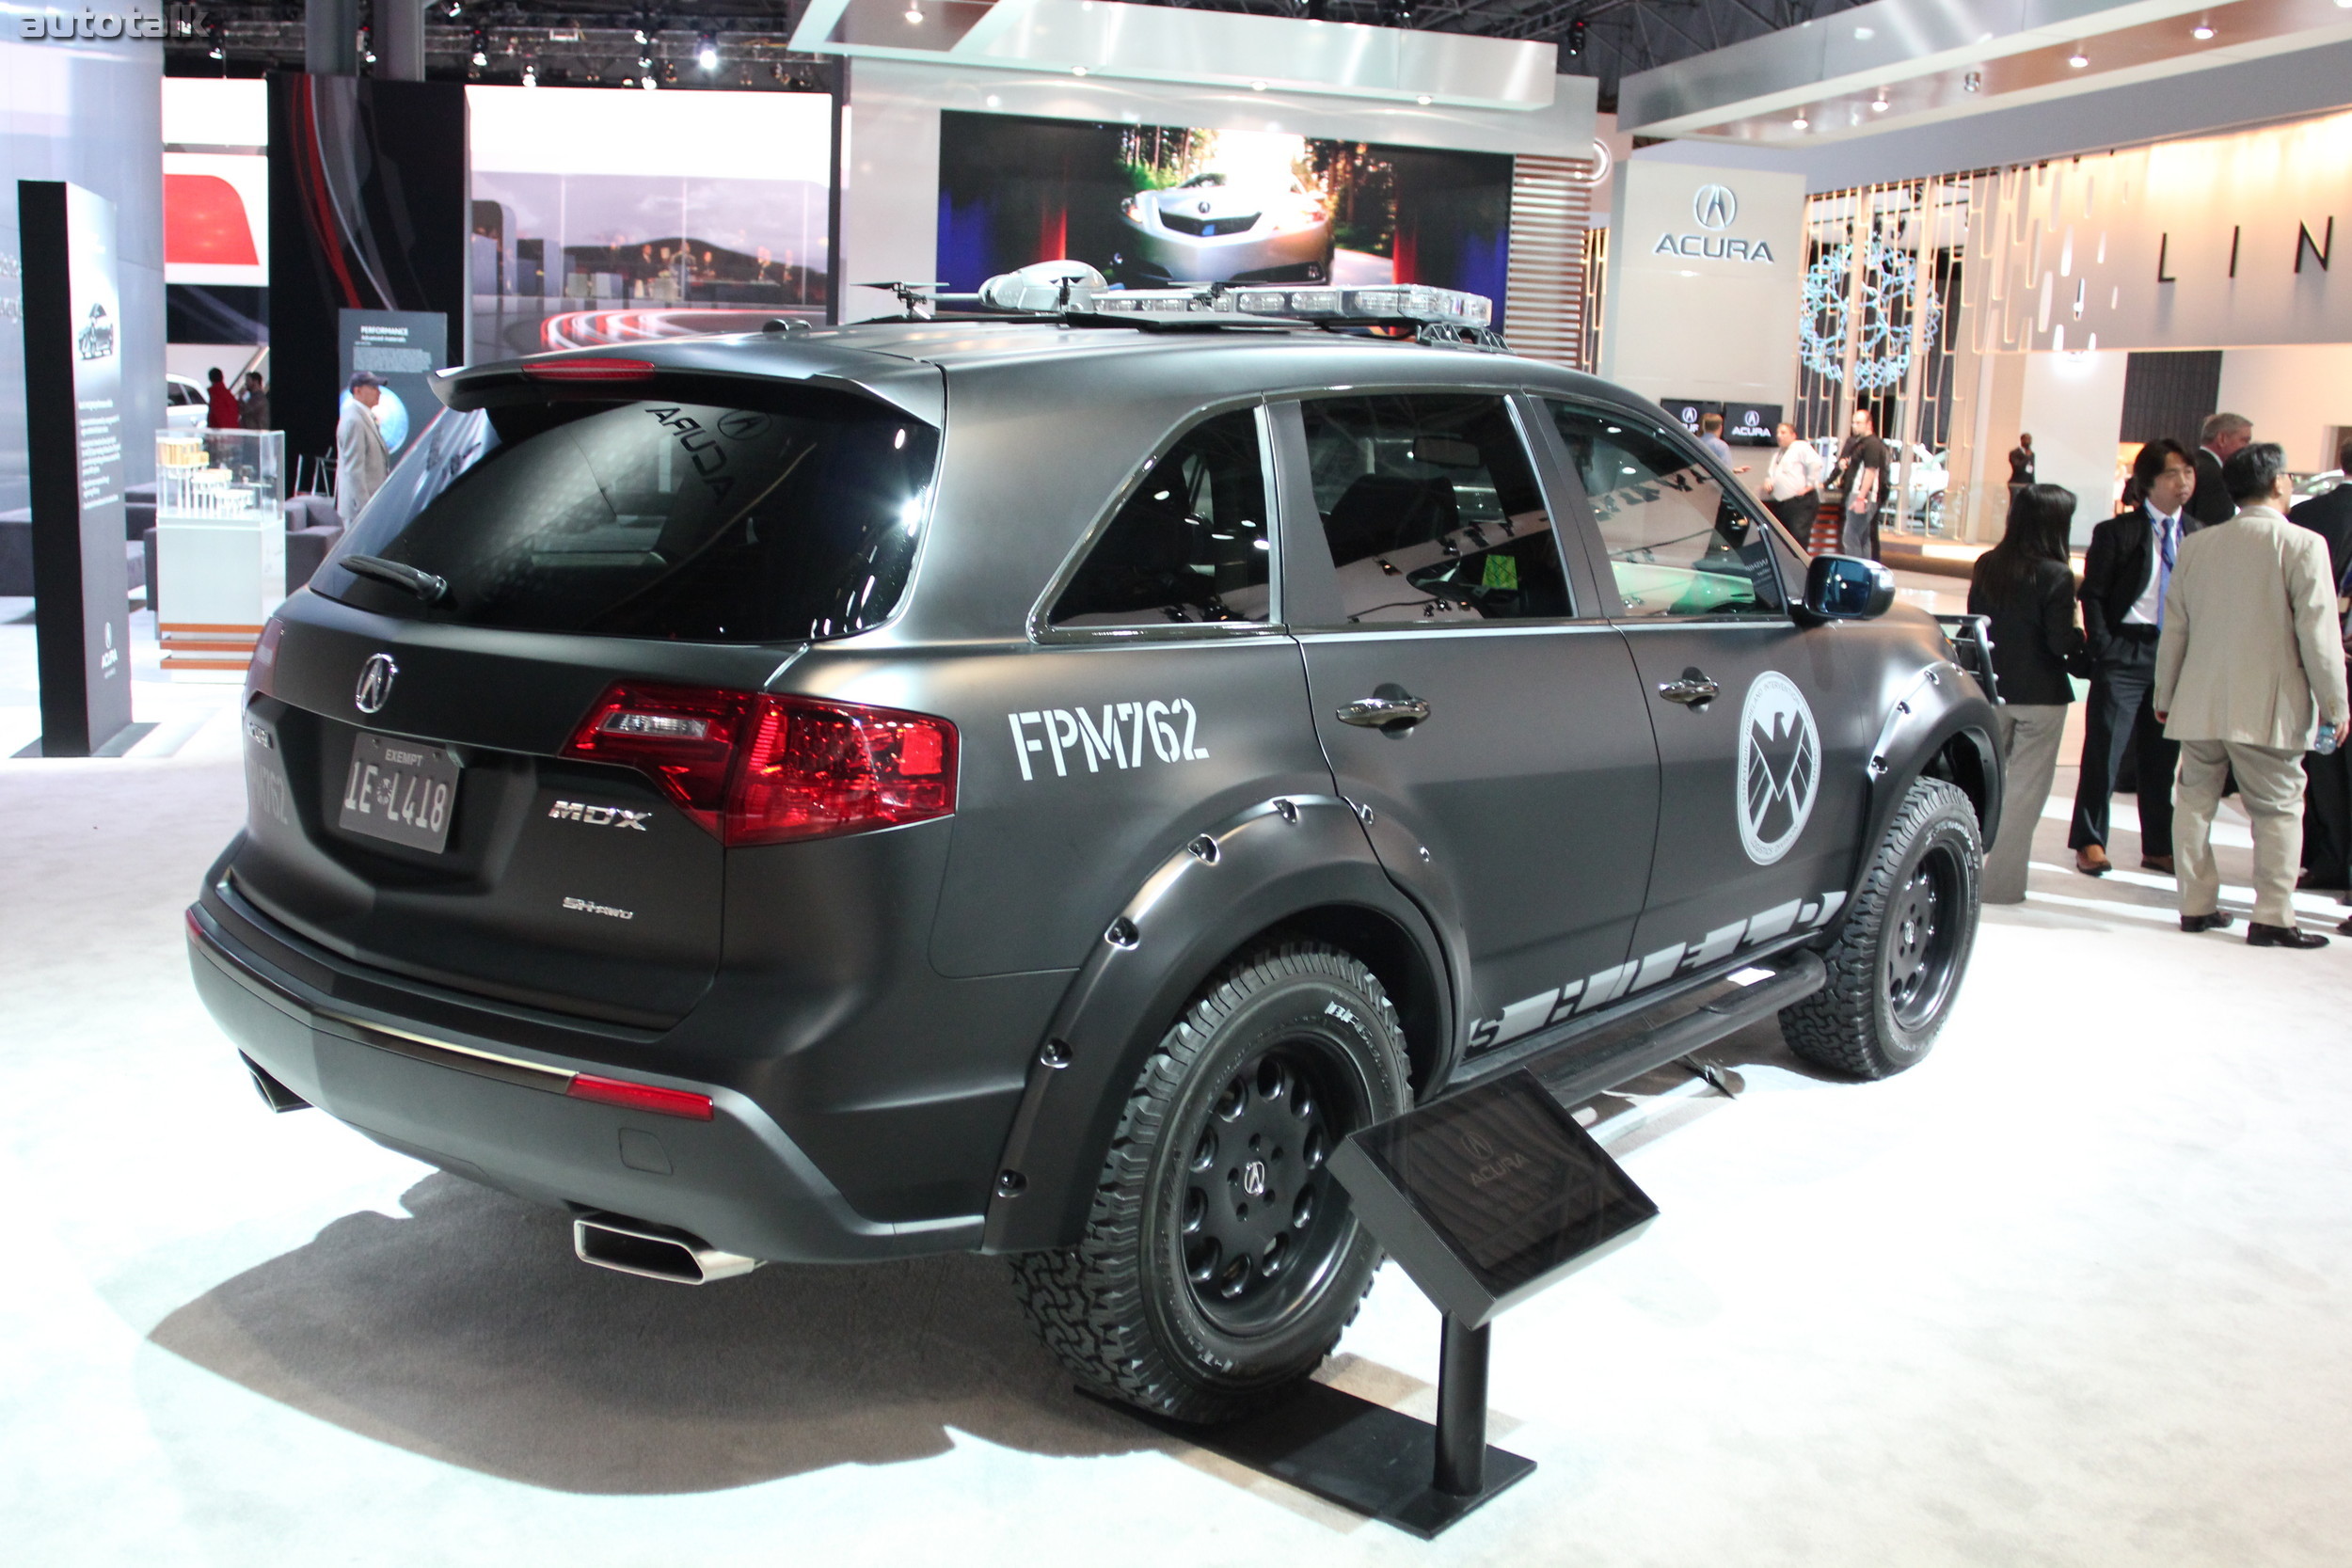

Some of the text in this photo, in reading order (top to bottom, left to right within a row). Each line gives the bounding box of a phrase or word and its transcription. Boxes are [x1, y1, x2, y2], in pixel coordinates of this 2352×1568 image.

[1652, 232, 1774, 264] ACURA
[360, 325, 409, 336] PERFORMANCE
[1731, 426, 1771, 437] ACURA
[1008, 698, 1210, 781] FPM762
[385, 749, 422, 767] EXEMPT
[548, 800, 652, 832] MDX
[563, 896, 633, 920] SH-AWD
[1470, 1152, 1532, 1188] ACURA
